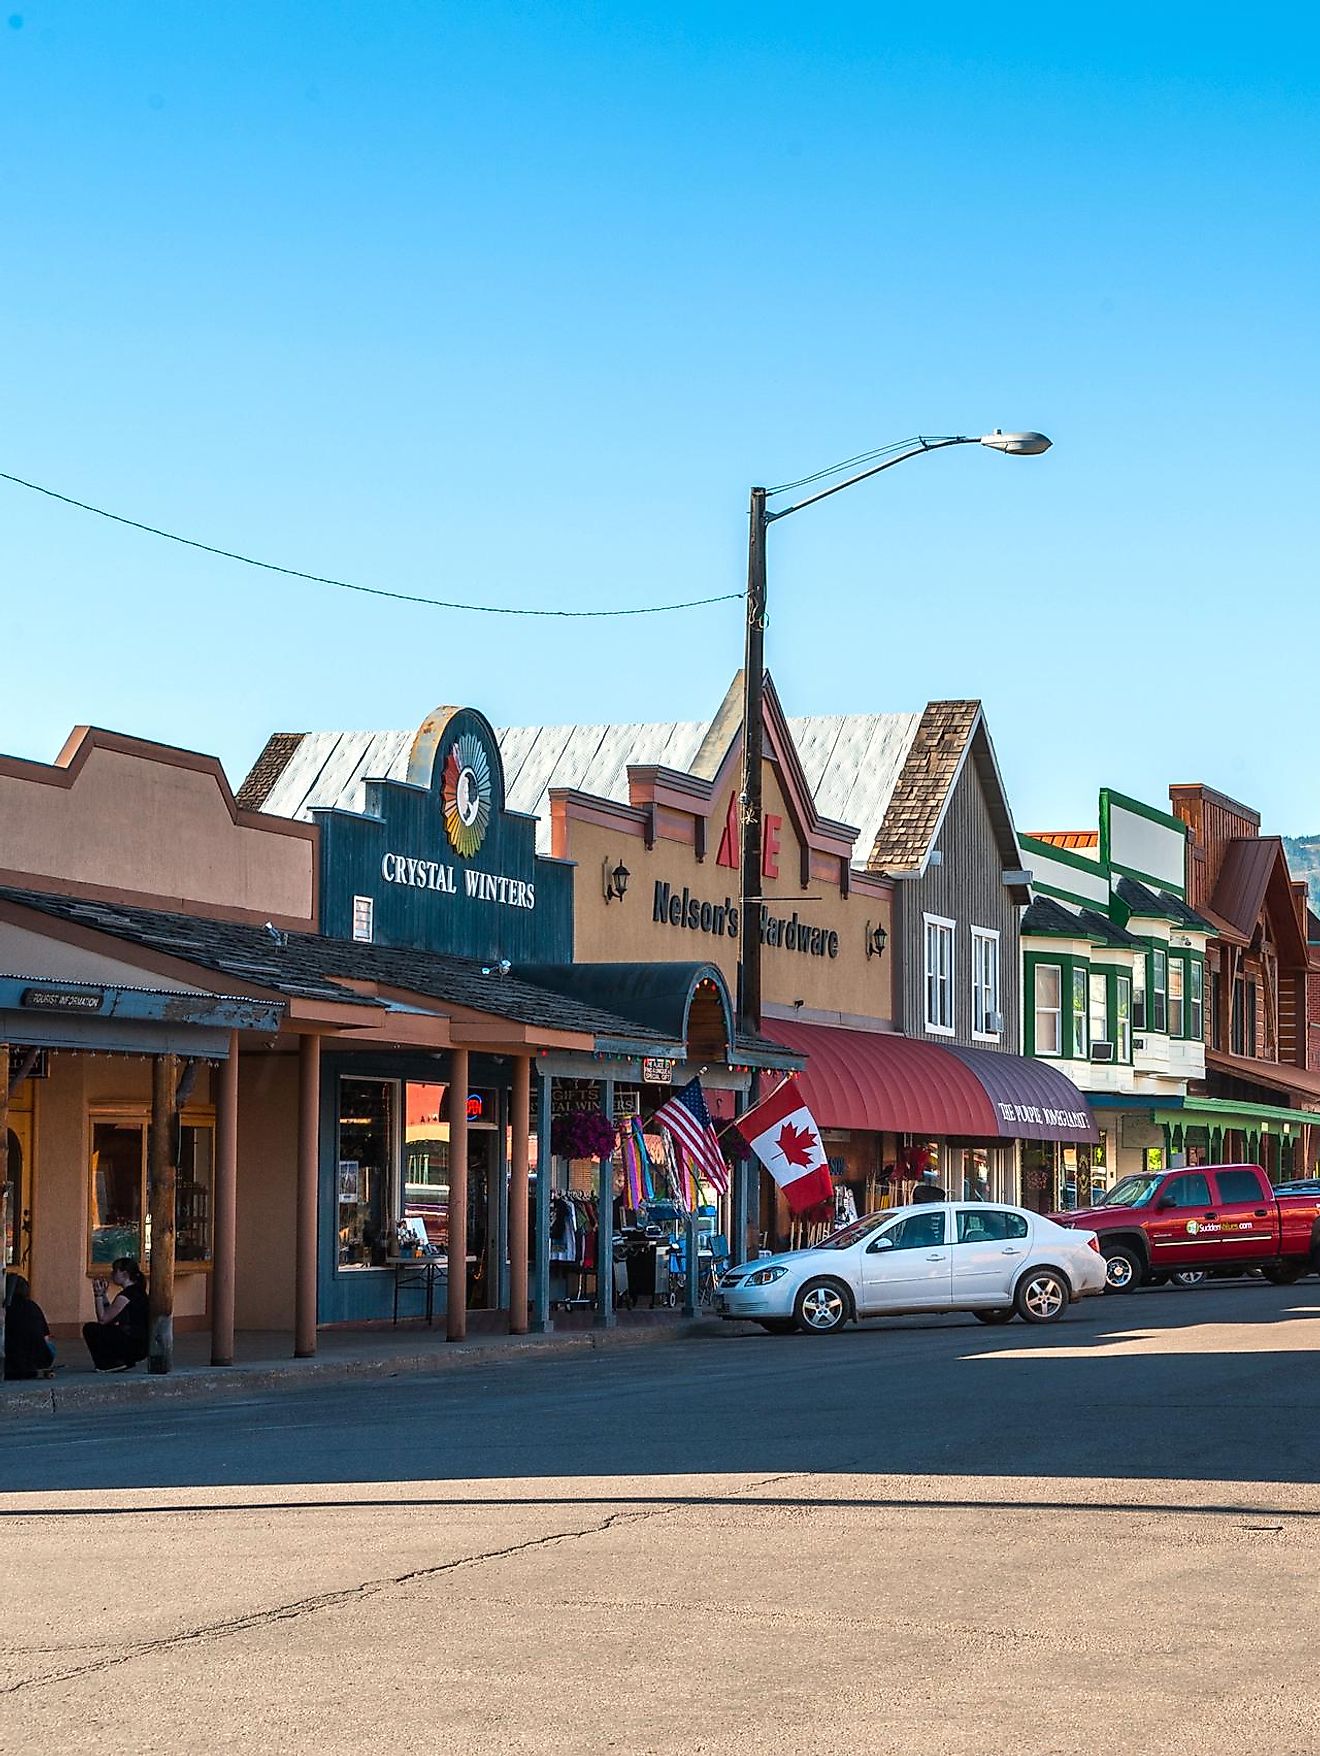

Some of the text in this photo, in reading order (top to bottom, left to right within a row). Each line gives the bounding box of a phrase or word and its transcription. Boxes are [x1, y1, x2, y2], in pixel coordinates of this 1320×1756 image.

[382, 853, 535, 910] CRYSTAL WINTERS
[653, 880, 738, 938] Nelson's
[552, 1089, 599, 1101] GIFTS
[998, 1102, 1016, 1121] THE
